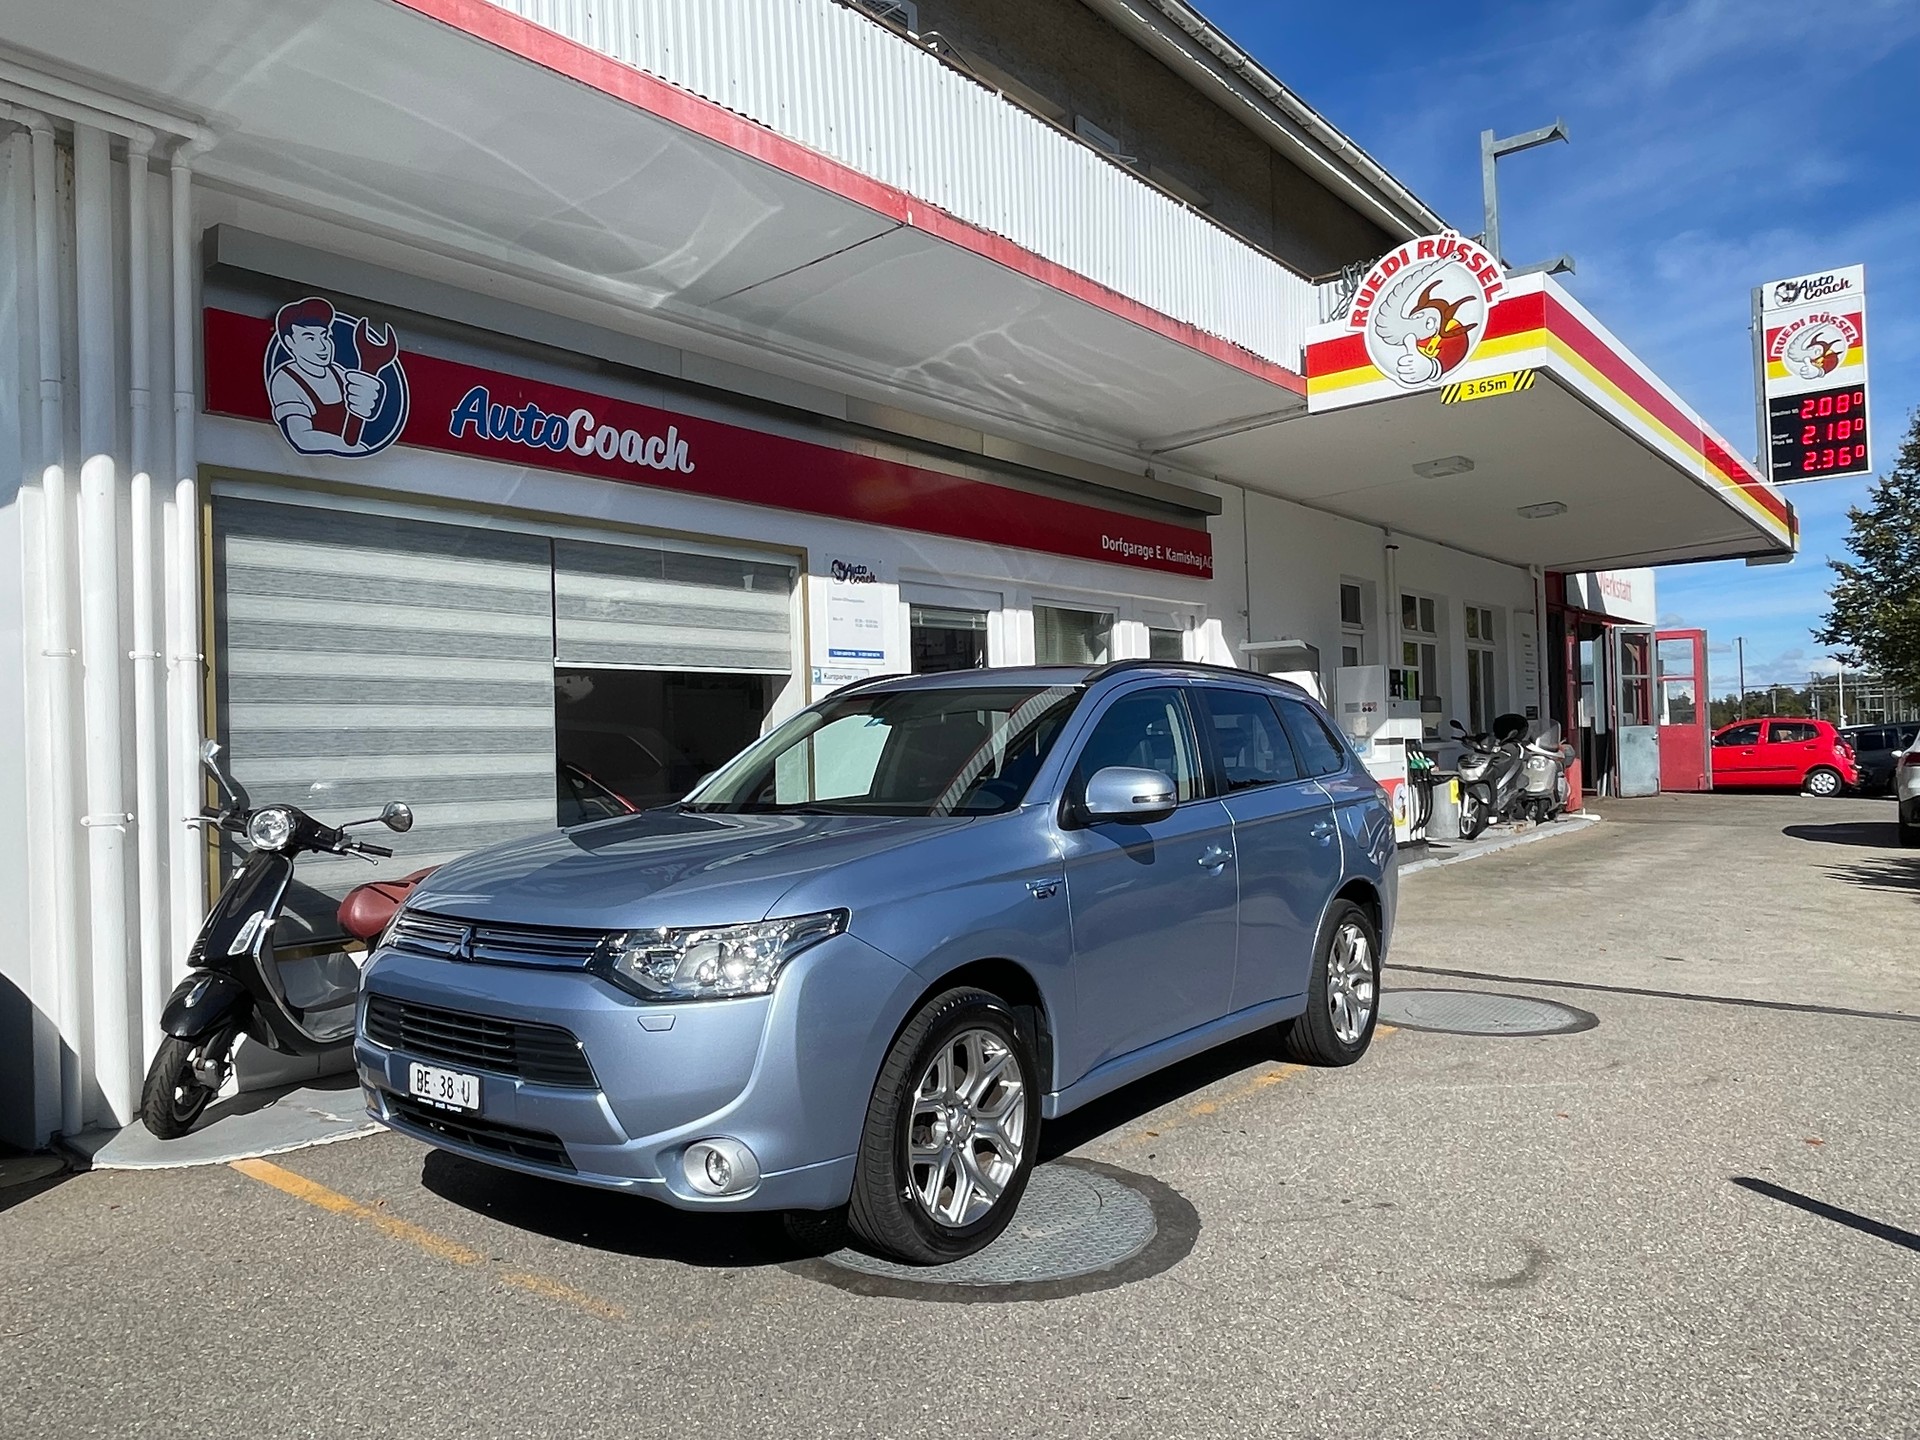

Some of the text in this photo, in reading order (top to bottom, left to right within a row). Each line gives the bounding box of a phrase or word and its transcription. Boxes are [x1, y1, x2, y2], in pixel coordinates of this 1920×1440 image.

[1350, 233, 1506, 328] RUEDI RÜSSEL
[1799, 275, 1835, 292] Auto
[1804, 277, 1853, 300] Coach
[1773, 312, 1856, 356] RUEDI RÜSSEL
[1467, 378, 1508, 395] 3.65m
[1101, 534, 1154, 560] Dorfgarage
[1155, 545, 1164, 559] E.
[1165, 547, 1202, 570] Kamishaj
[847, 563, 868, 575] Auto
[849, 571, 878, 584] Coach
[417, 1069, 431, 1094] BE
[439, 1075, 454, 1100] 38
